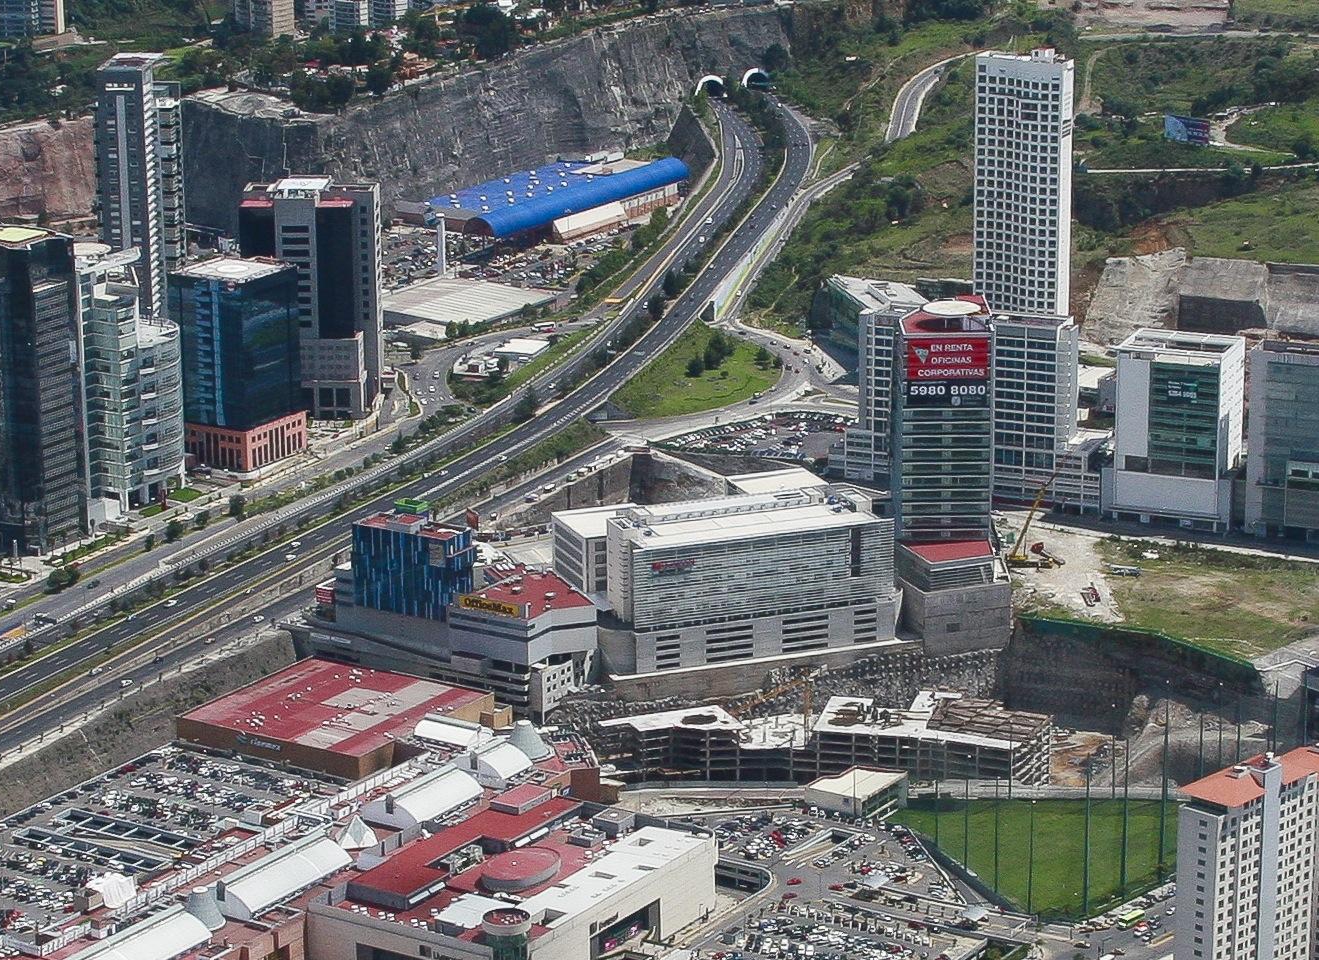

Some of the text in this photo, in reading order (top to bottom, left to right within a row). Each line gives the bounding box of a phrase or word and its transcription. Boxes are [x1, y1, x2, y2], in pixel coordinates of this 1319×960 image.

[931, 344, 973, 352] EN RENTA
[918, 369, 985, 377] CORPORATIVAS
[910, 386, 986, 395] 5980 8080
